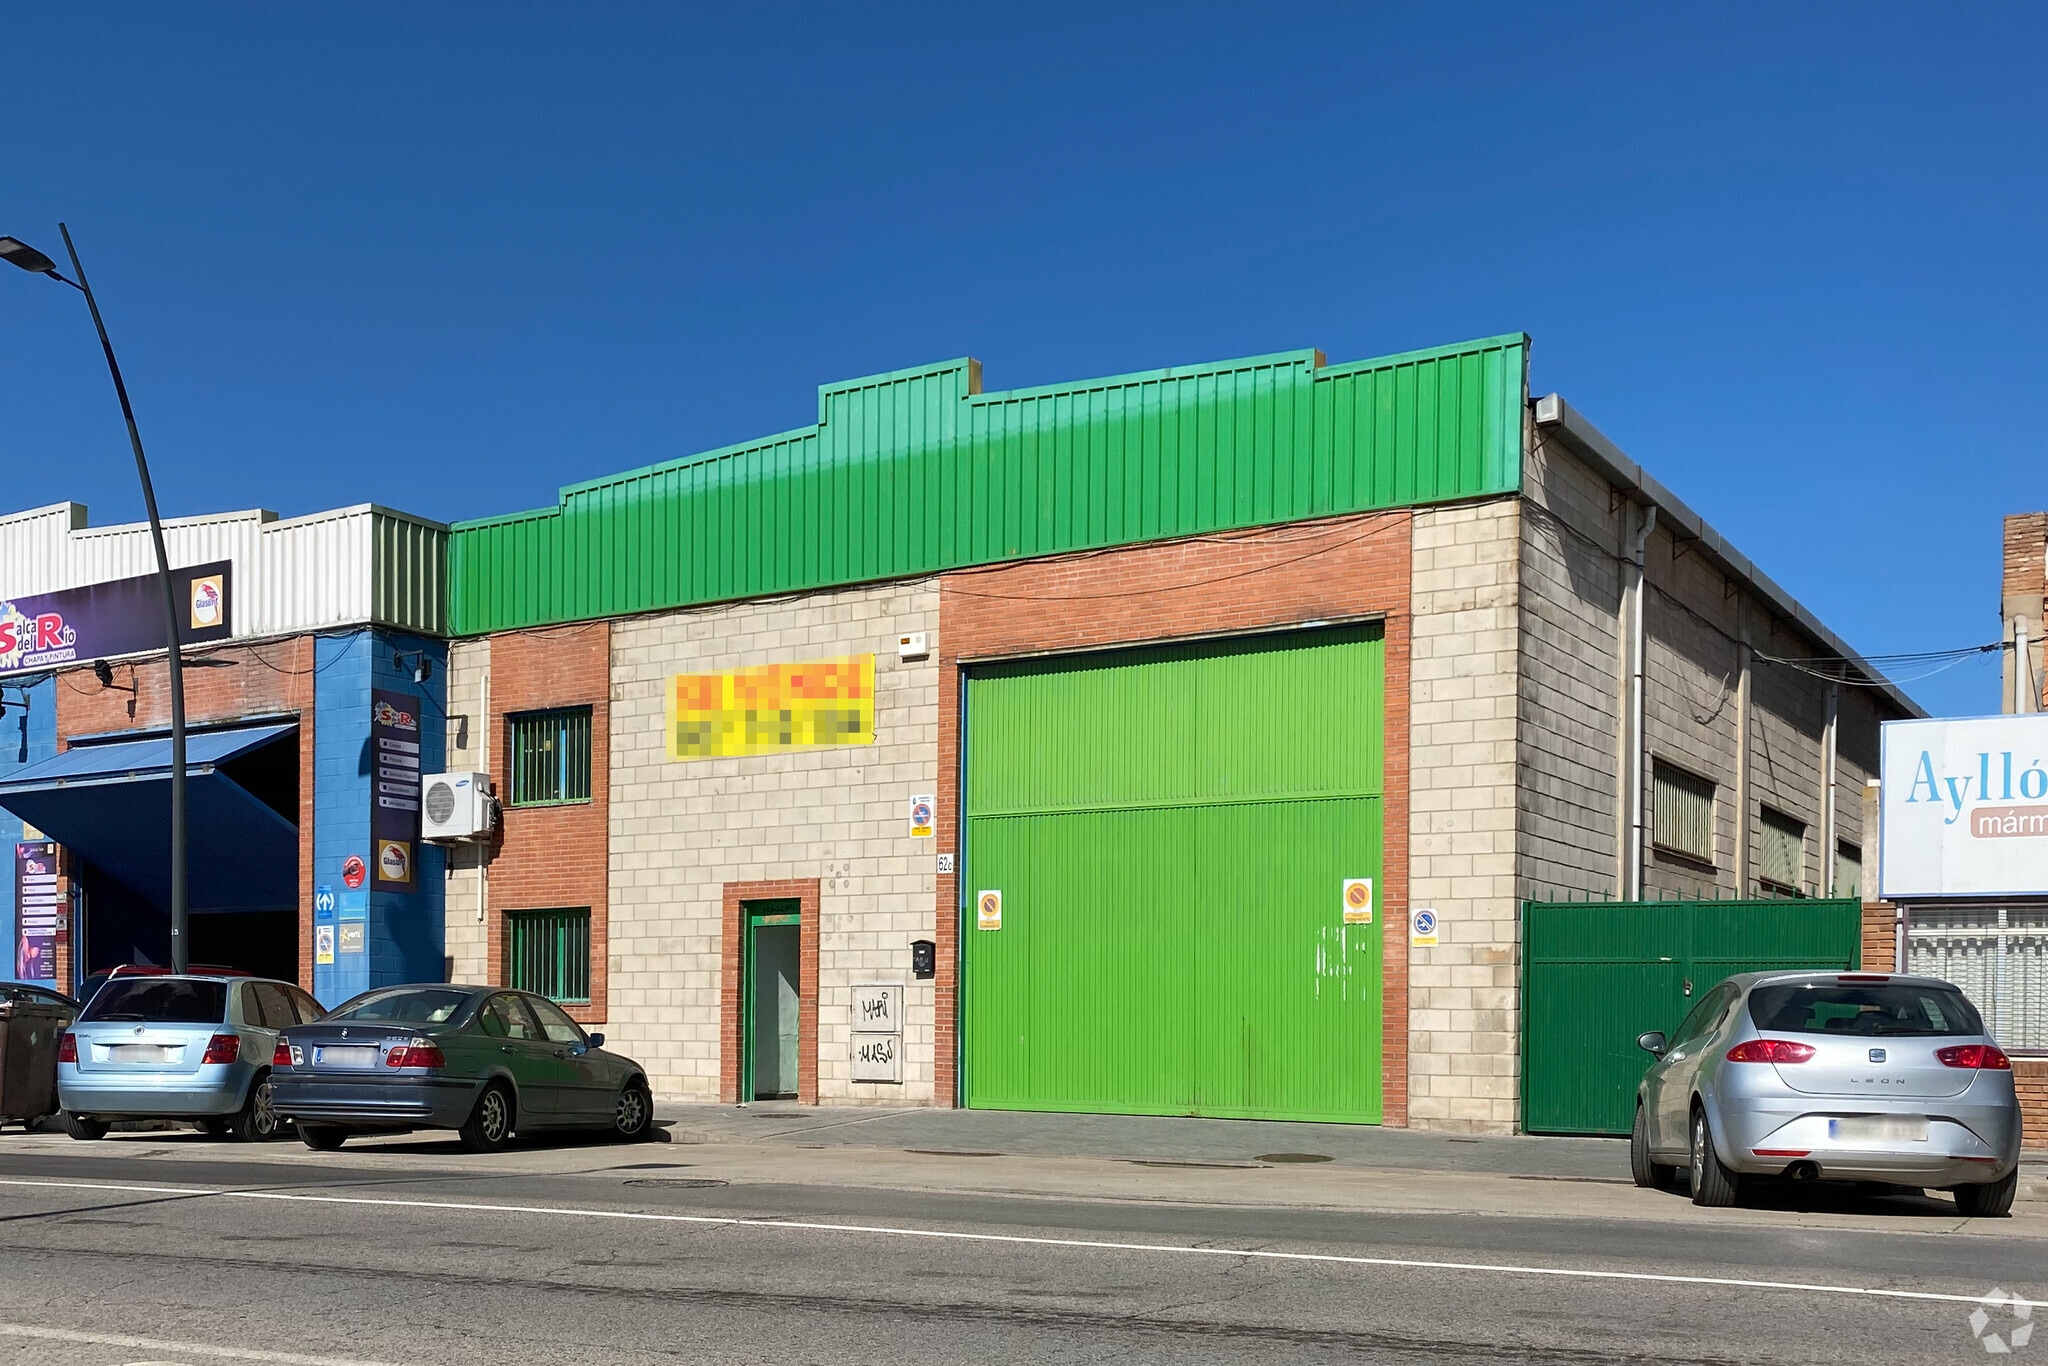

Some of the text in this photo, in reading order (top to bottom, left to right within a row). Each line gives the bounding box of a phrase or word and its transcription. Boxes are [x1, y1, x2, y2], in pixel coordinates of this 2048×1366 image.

[17, 633, 33, 651] del
[25, 654, 43, 665] CHAPA
[49, 650, 75, 662] PINTURA
